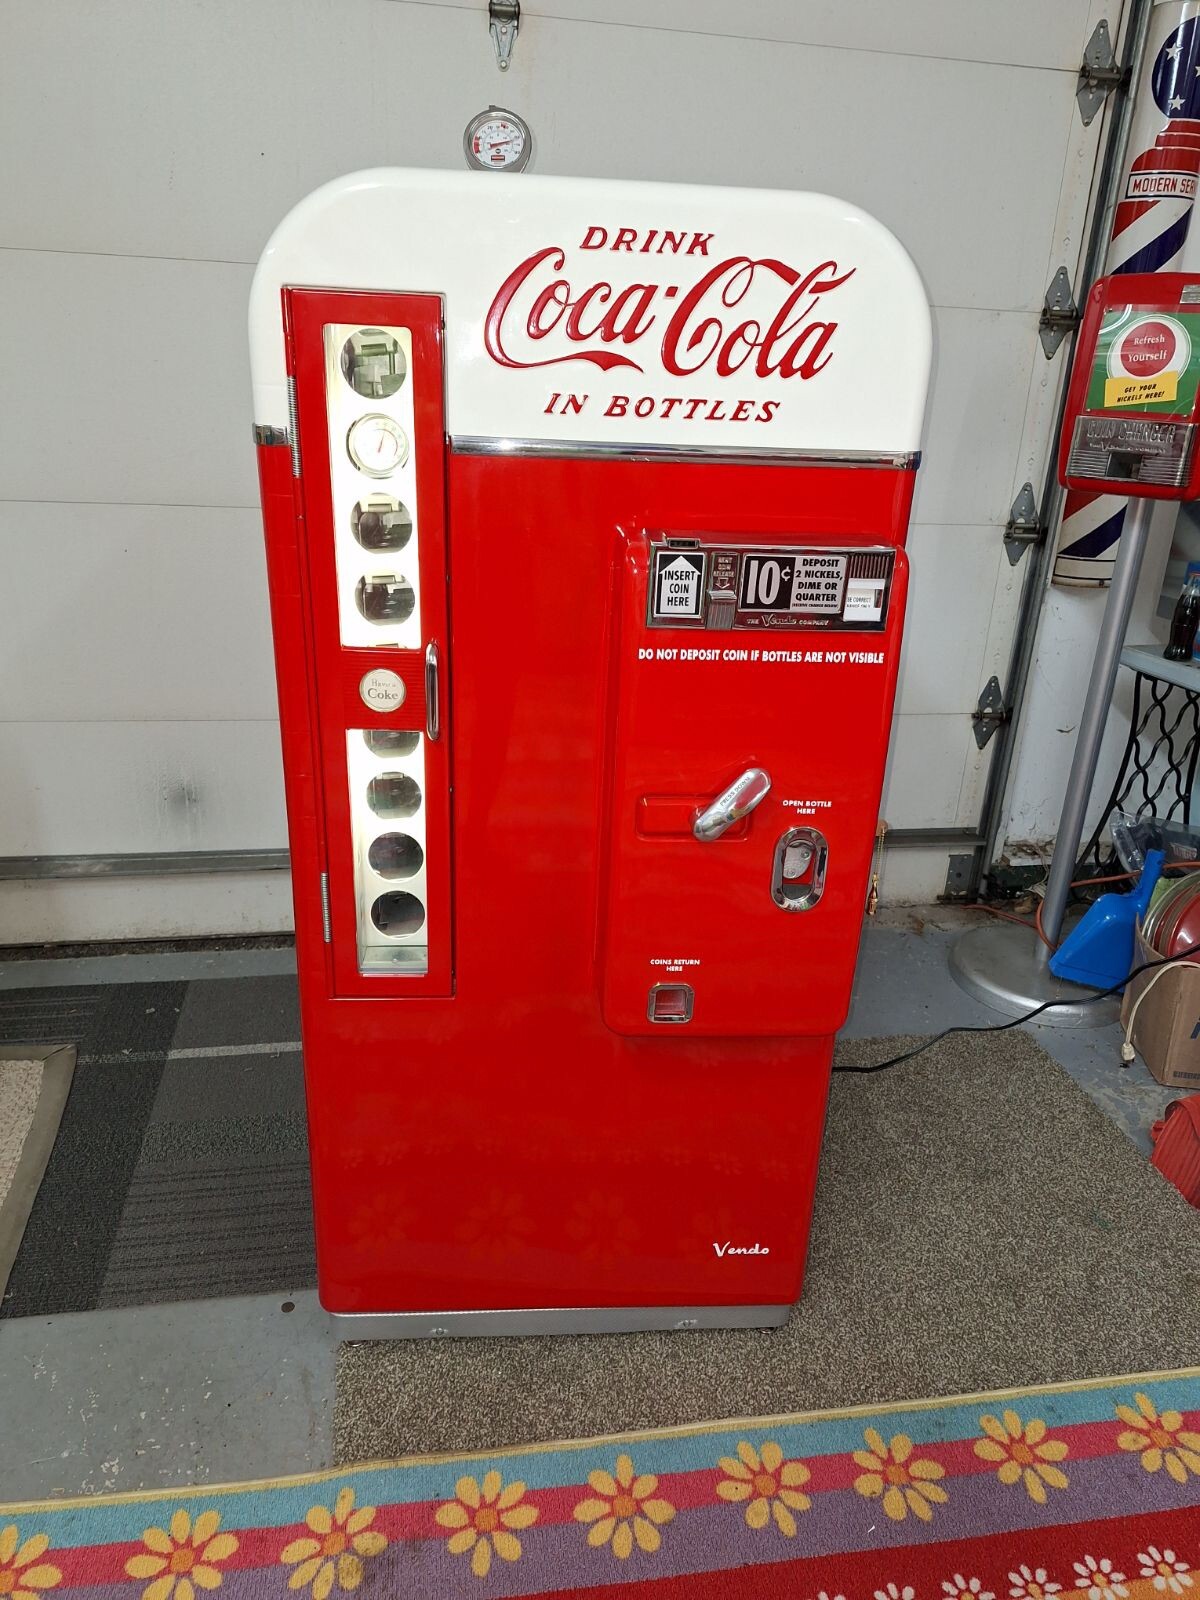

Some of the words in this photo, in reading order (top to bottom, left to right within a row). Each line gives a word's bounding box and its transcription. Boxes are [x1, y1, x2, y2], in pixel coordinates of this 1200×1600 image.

[1132, 177, 1178, 193] MODERN
[579, 226, 715, 256] DRINK
[484, 246, 857, 380] Coca-Cola
[1133, 334, 1165, 345] Refresh
[1128, 350, 1167, 362] Yourself
[1117, 394, 1143, 402] NICKELS
[544, 393, 588, 415] IN
[604, 395, 781, 423] BOTTLES
[802, 558, 840, 567] DEPOSIT
[664, 570, 696, 581] INSERT
[795, 570, 802, 578] 2
[804, 570, 843, 580] NICKELS,
[669, 583, 690, 594] COIN
[798, 582, 822, 590] DIME
[824, 582, 838, 590] OR
[667, 596, 690, 607] HERE
[795, 592, 837, 602] QUARTER
[638, 648, 654, 660] DO
[656, 648, 678, 660] NOT
[680, 649, 721, 661] DEPOSIT
[722, 649, 748, 661] COIN
[750, 650, 760, 661] IF
[762, 650, 802, 662] BOTTLES
[803, 651, 824, 662] ARE
[825, 651, 847, 663] NOT
[848, 652, 885, 664] VISIBLE
[367, 688, 399, 700] Coke
[805, 800, 832, 808] BOTTLE
[712, 1241, 770, 1257] Vendo
